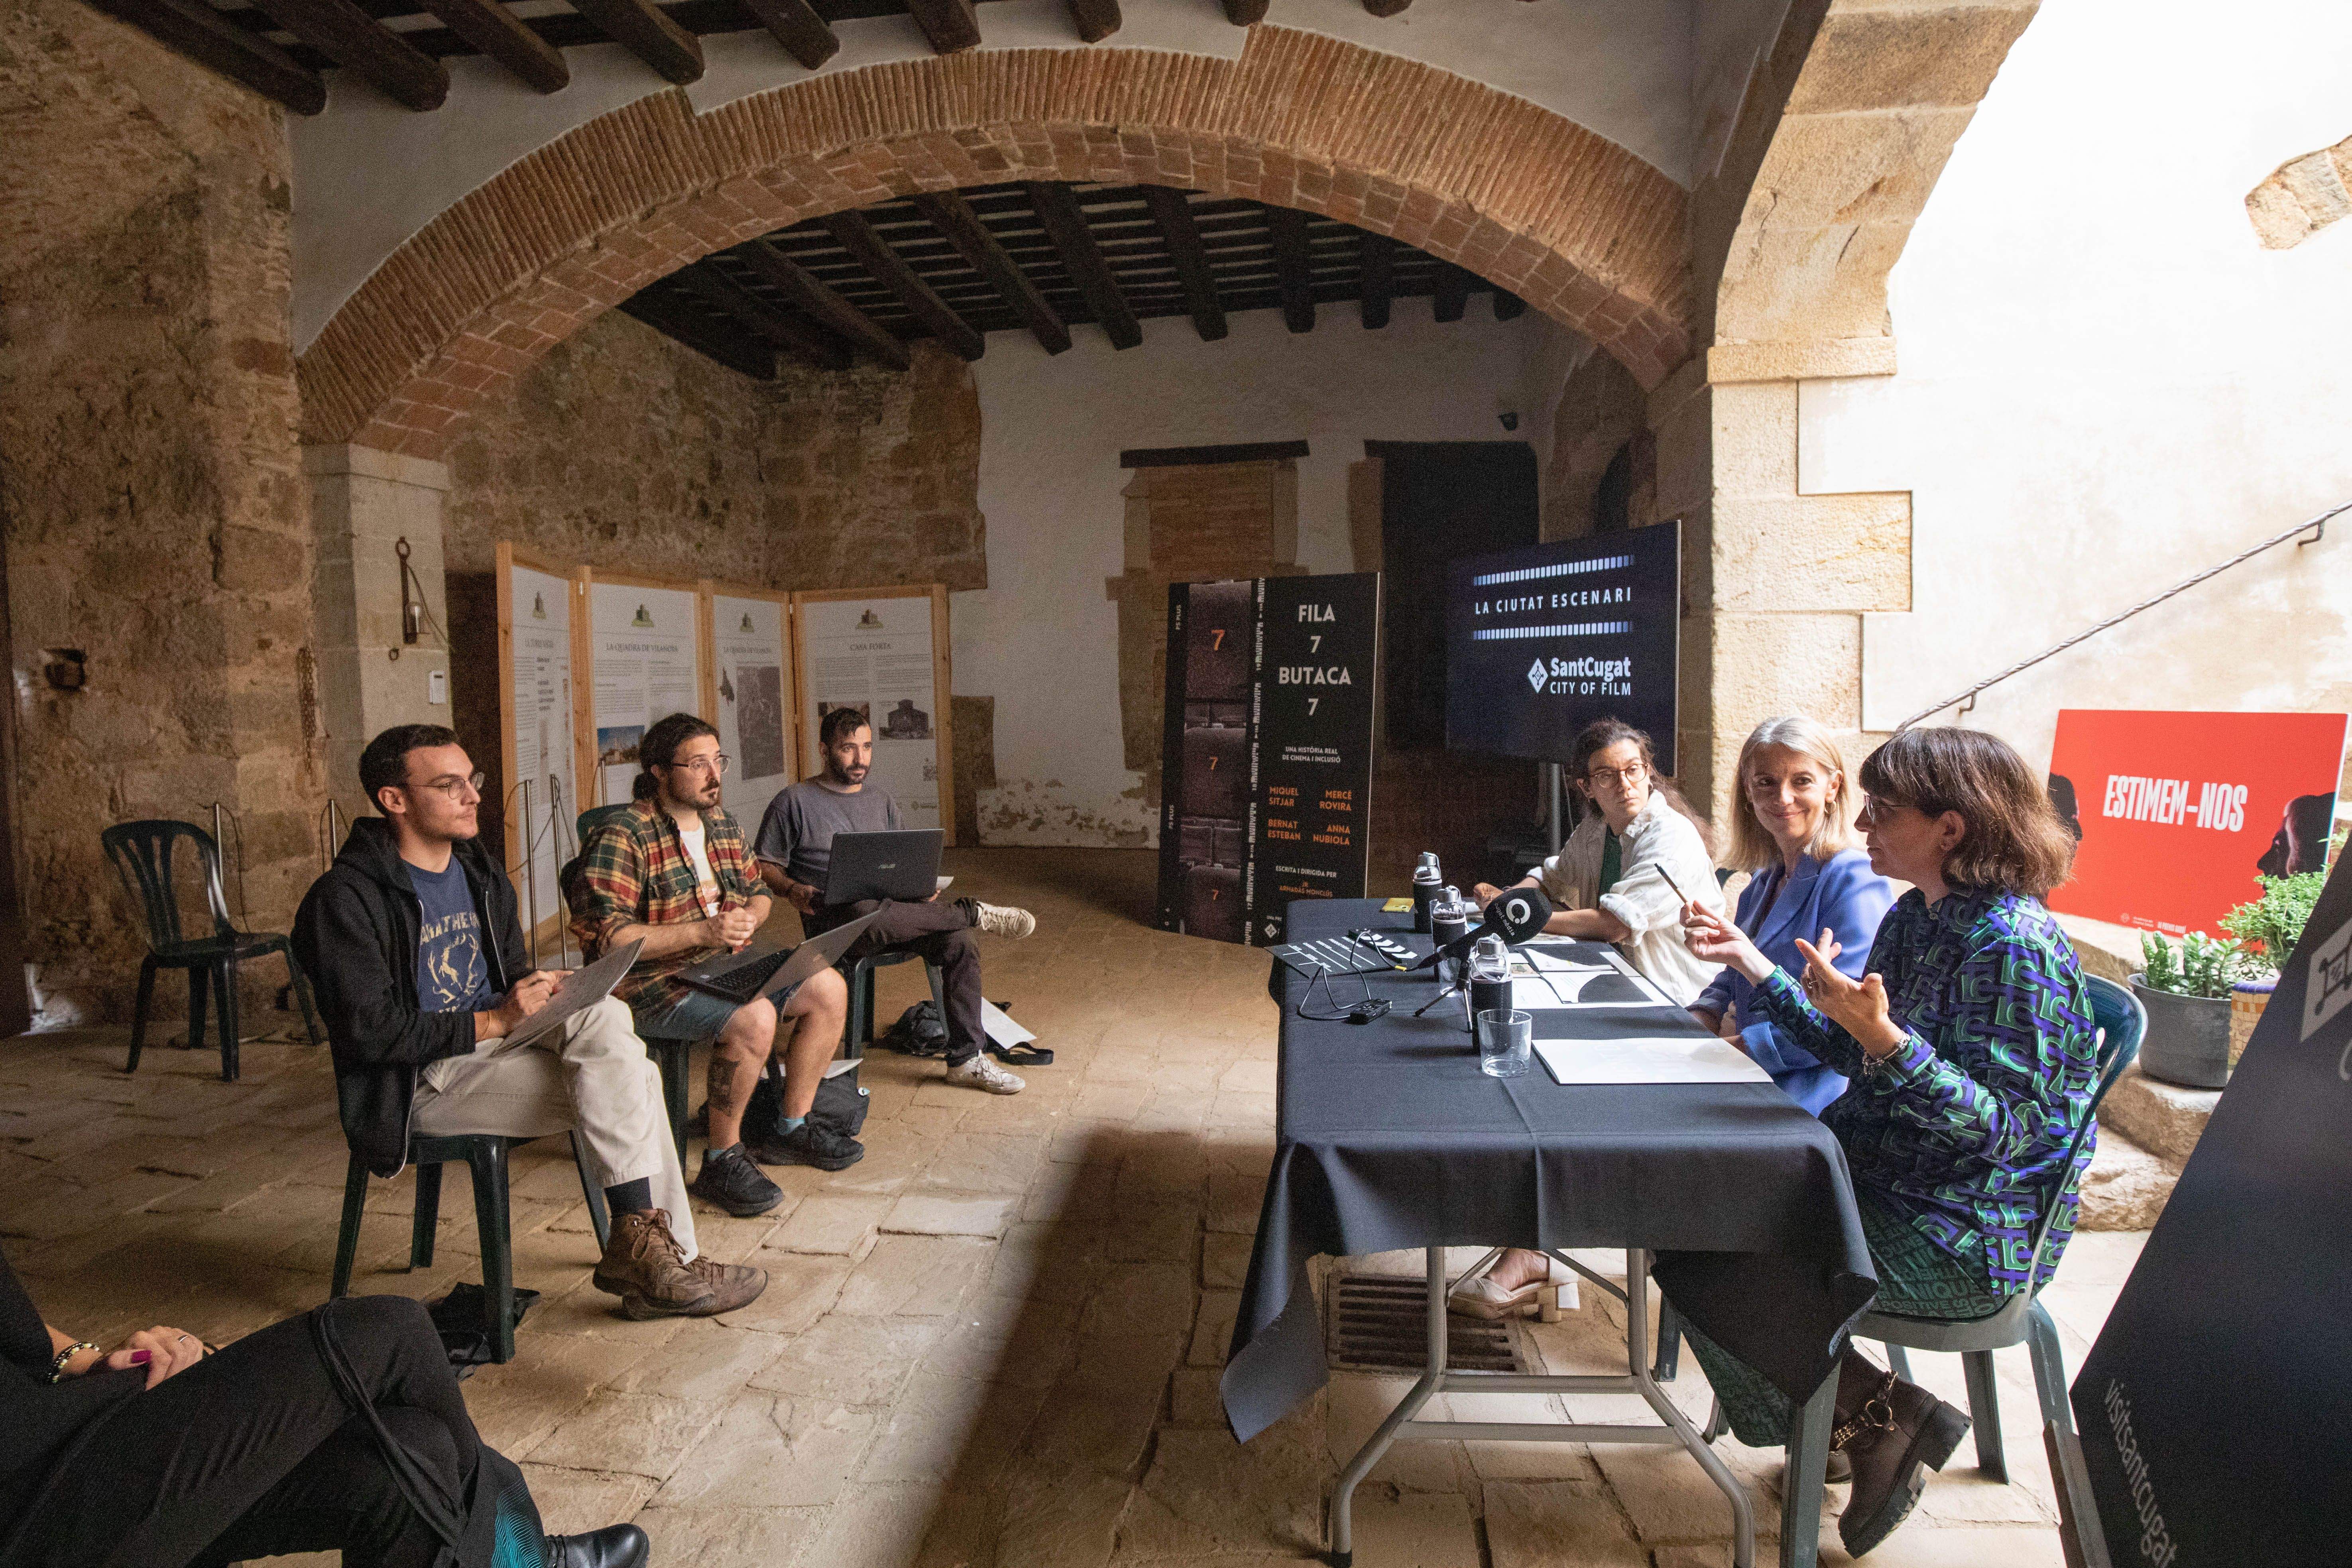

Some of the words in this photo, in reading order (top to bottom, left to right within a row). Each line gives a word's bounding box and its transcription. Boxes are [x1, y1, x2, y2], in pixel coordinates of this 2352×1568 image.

[1475, 601, 1489, 615] LA
[1496, 596, 1543, 613] CIUTAT
[1552, 586, 1632, 608] ESCENARI
[1298, 604, 1336, 623] FILA
[1211, 629, 1225, 651] 7
[1310, 635, 1322, 654] 7
[1278, 666, 1352, 685] BUTACA
[1550, 656, 1632, 683] SantCugat
[1550, 681, 1575, 694] CITY
[1581, 681, 1596, 694] OF
[1601, 681, 1632, 696] FILM
[1308, 698, 1320, 717] 7
[1209, 756, 1218, 771] 7
[1315, 754, 1341, 763] INCLUSIÓ
[1269, 786, 1299, 797] MIQUEL
[1269, 796, 1294, 807] SITJAR
[1319, 801, 1352, 812] ROVIRA
[2102, 774, 2248, 832] ESTIMEM-NOS
[1268, 818, 1298, 830] BERNAT
[1327, 823, 1351, 834] ANNA
[1267, 829, 1301, 840] ESTEBAN
[1313, 833, 1350, 846] NUBIOLA
[1276, 864, 1296, 874] ESCRITA
[1301, 866, 1325, 877] DIRIGIDA
[1327, 869, 1337, 878] PER
[1212, 888, 1219, 900] 7
